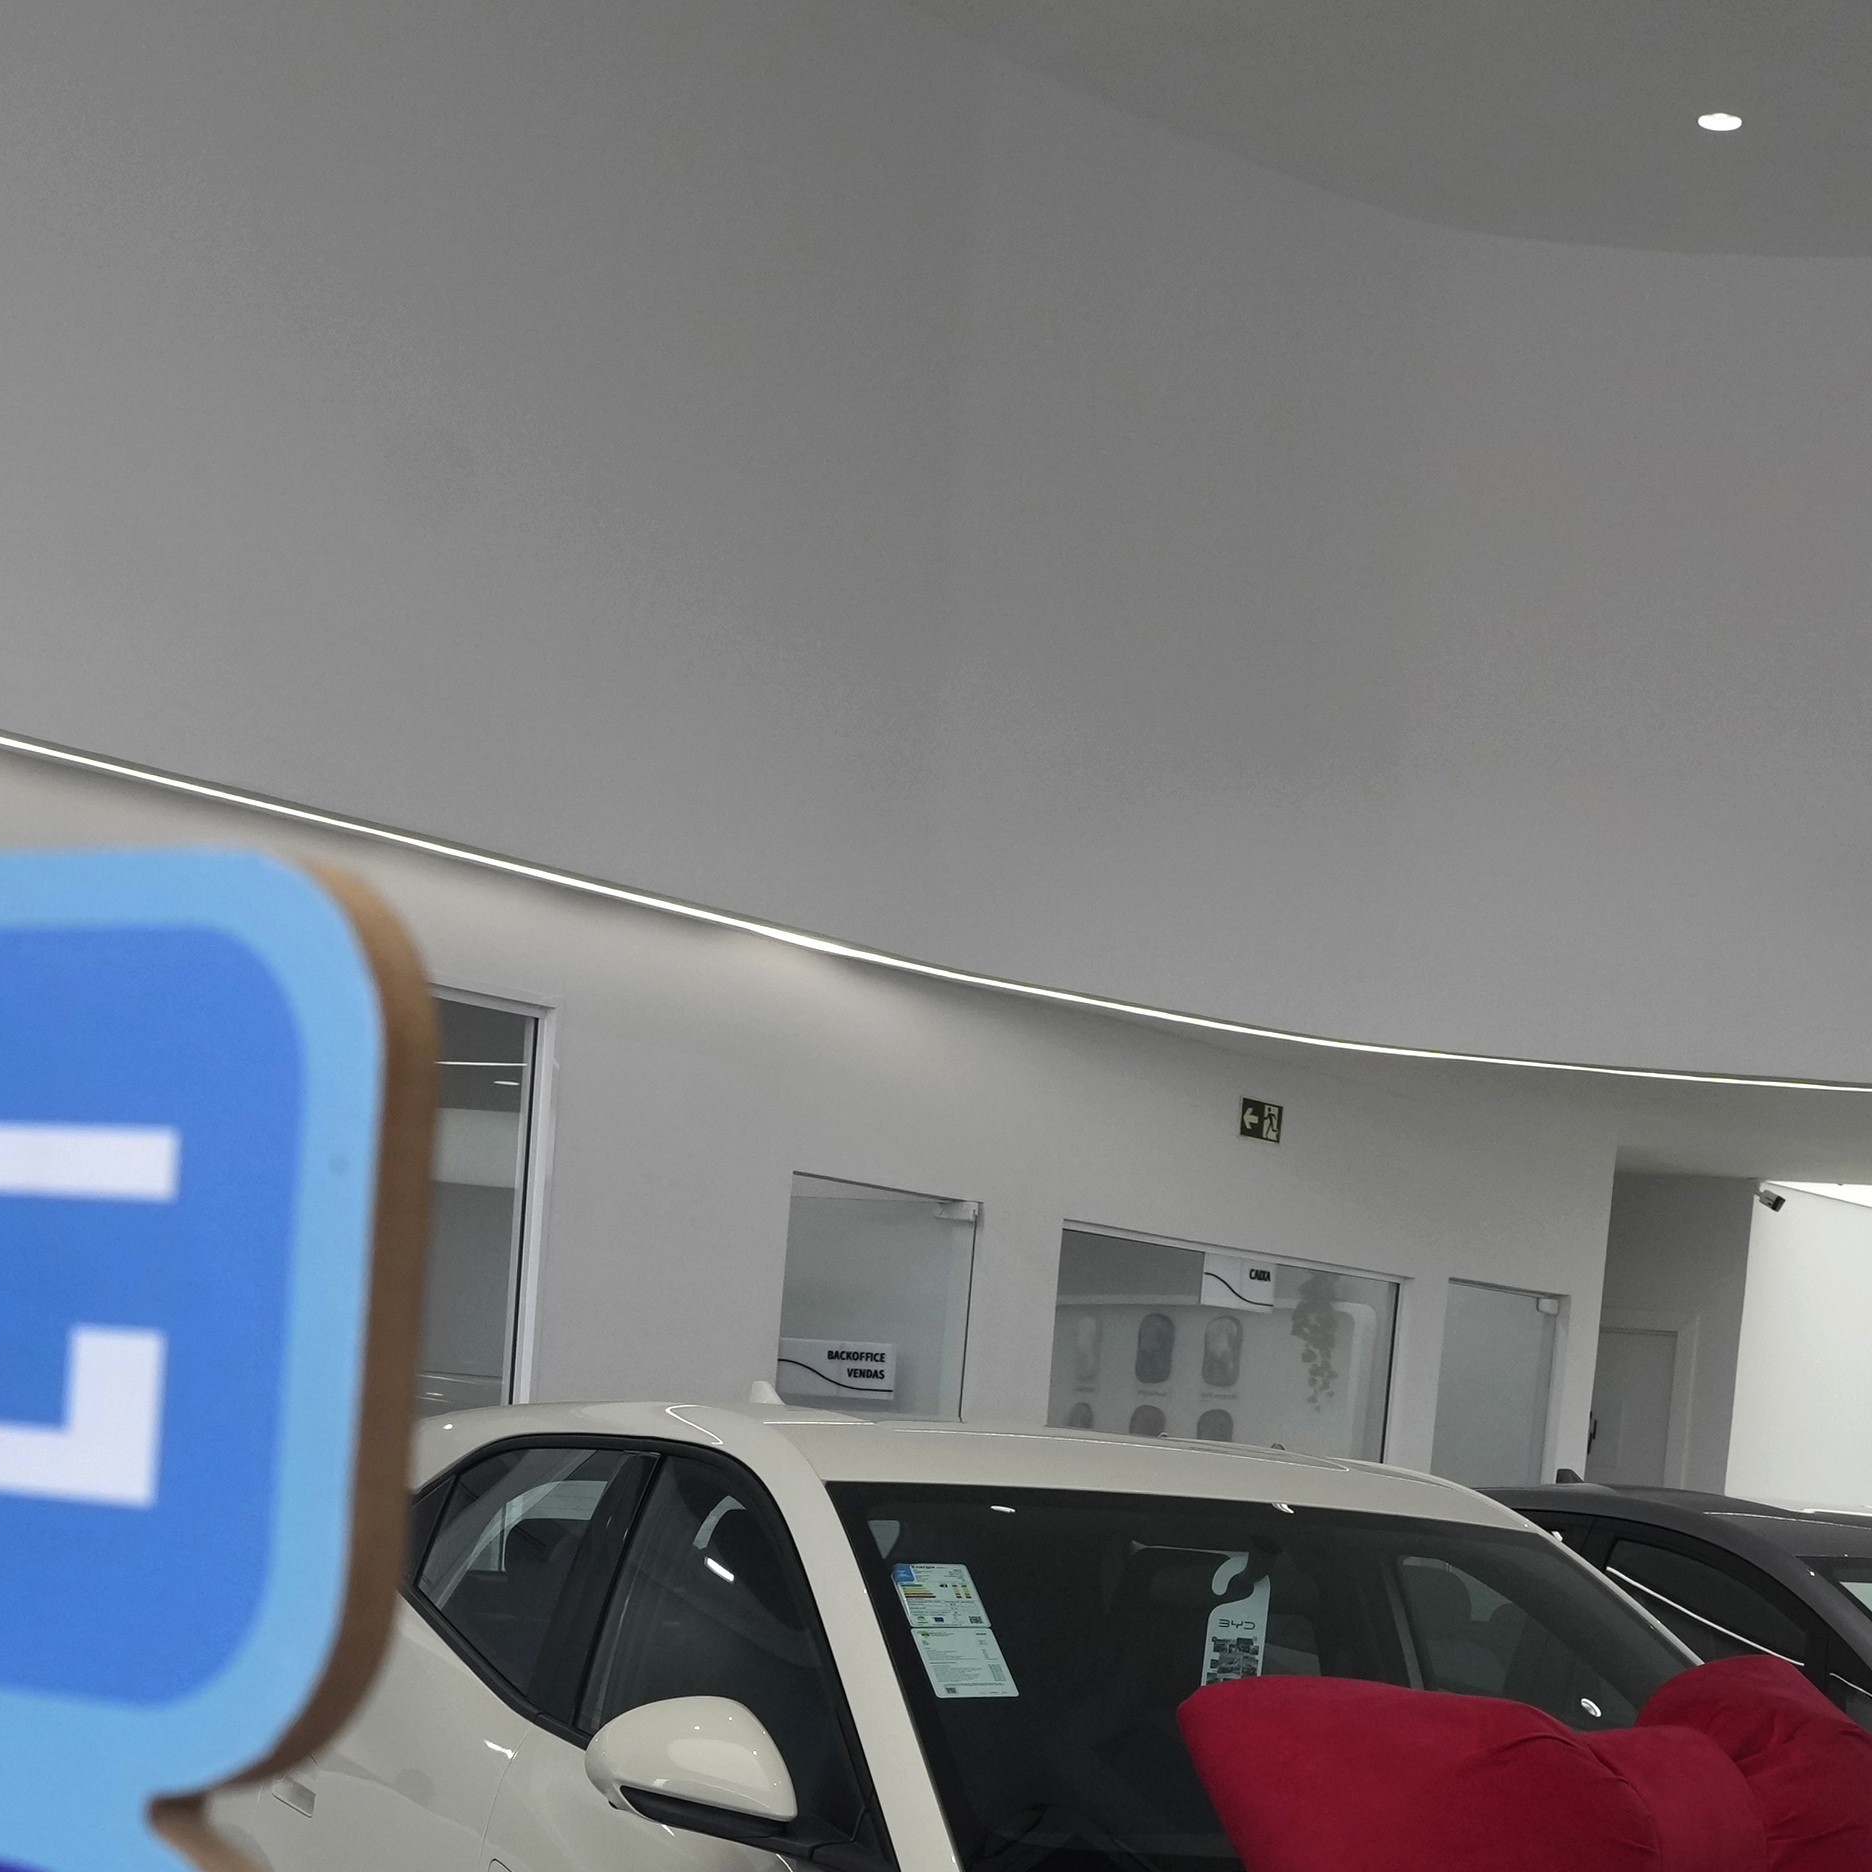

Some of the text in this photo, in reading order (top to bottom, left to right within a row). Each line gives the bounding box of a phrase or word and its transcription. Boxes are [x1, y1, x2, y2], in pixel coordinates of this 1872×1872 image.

[827, 1350, 886, 1363] BACKOFFICE
[846, 1368, 885, 1380] VENDAS
[1218, 1618, 1256, 1631] BYD
